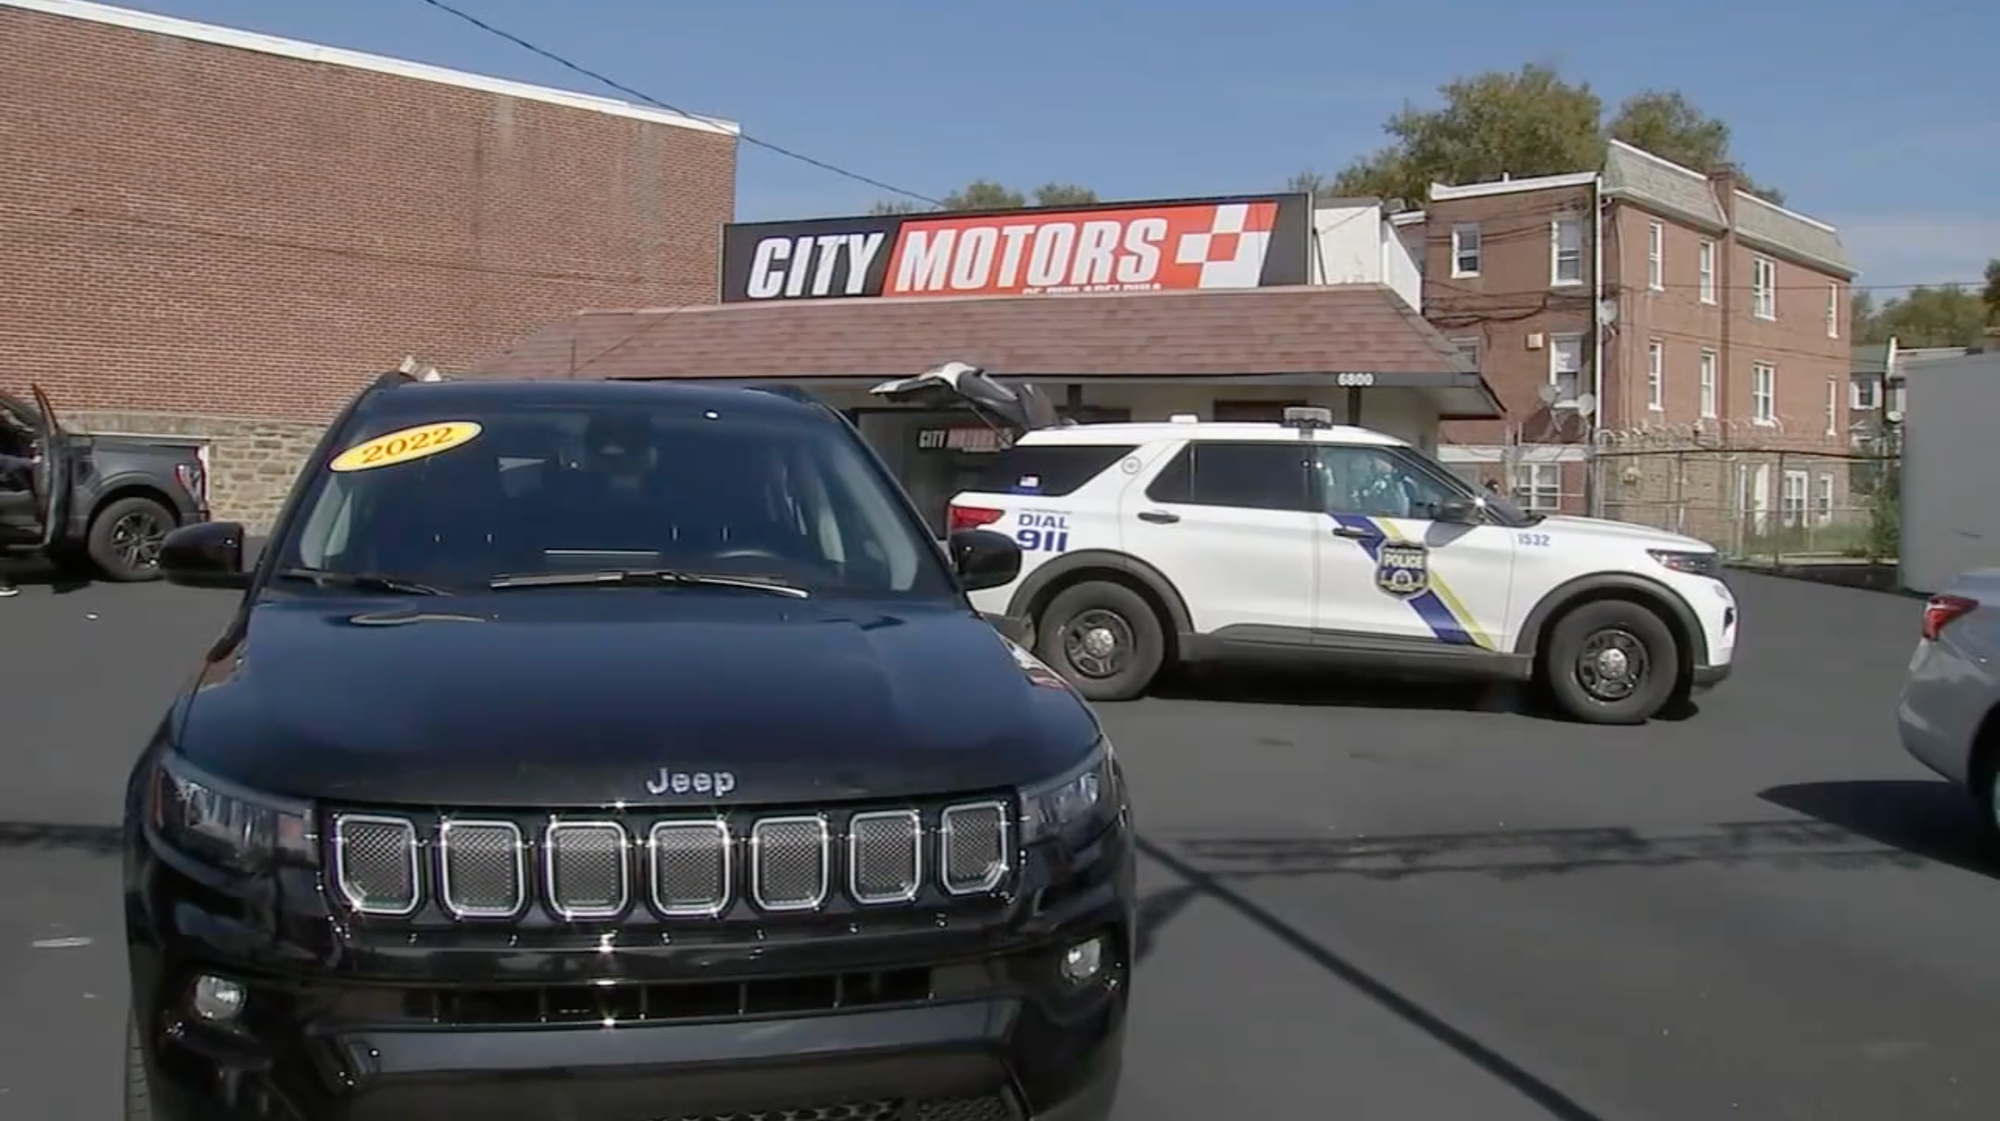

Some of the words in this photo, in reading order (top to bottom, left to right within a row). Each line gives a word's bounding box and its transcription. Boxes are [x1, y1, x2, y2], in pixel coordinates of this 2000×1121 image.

[747, 232, 885, 298] CITY
[894, 218, 1168, 292] MOTORS
[1338, 373, 1374, 386] 6800
[362, 427, 454, 464] 2022
[919, 431, 946, 448] CITY
[1018, 513, 1070, 529] DIAL
[1016, 529, 1069, 552] 911
[1518, 533, 1551, 547] 1532
[1384, 553, 1424, 569] POLICE
[646, 767, 735, 797] Jeep
